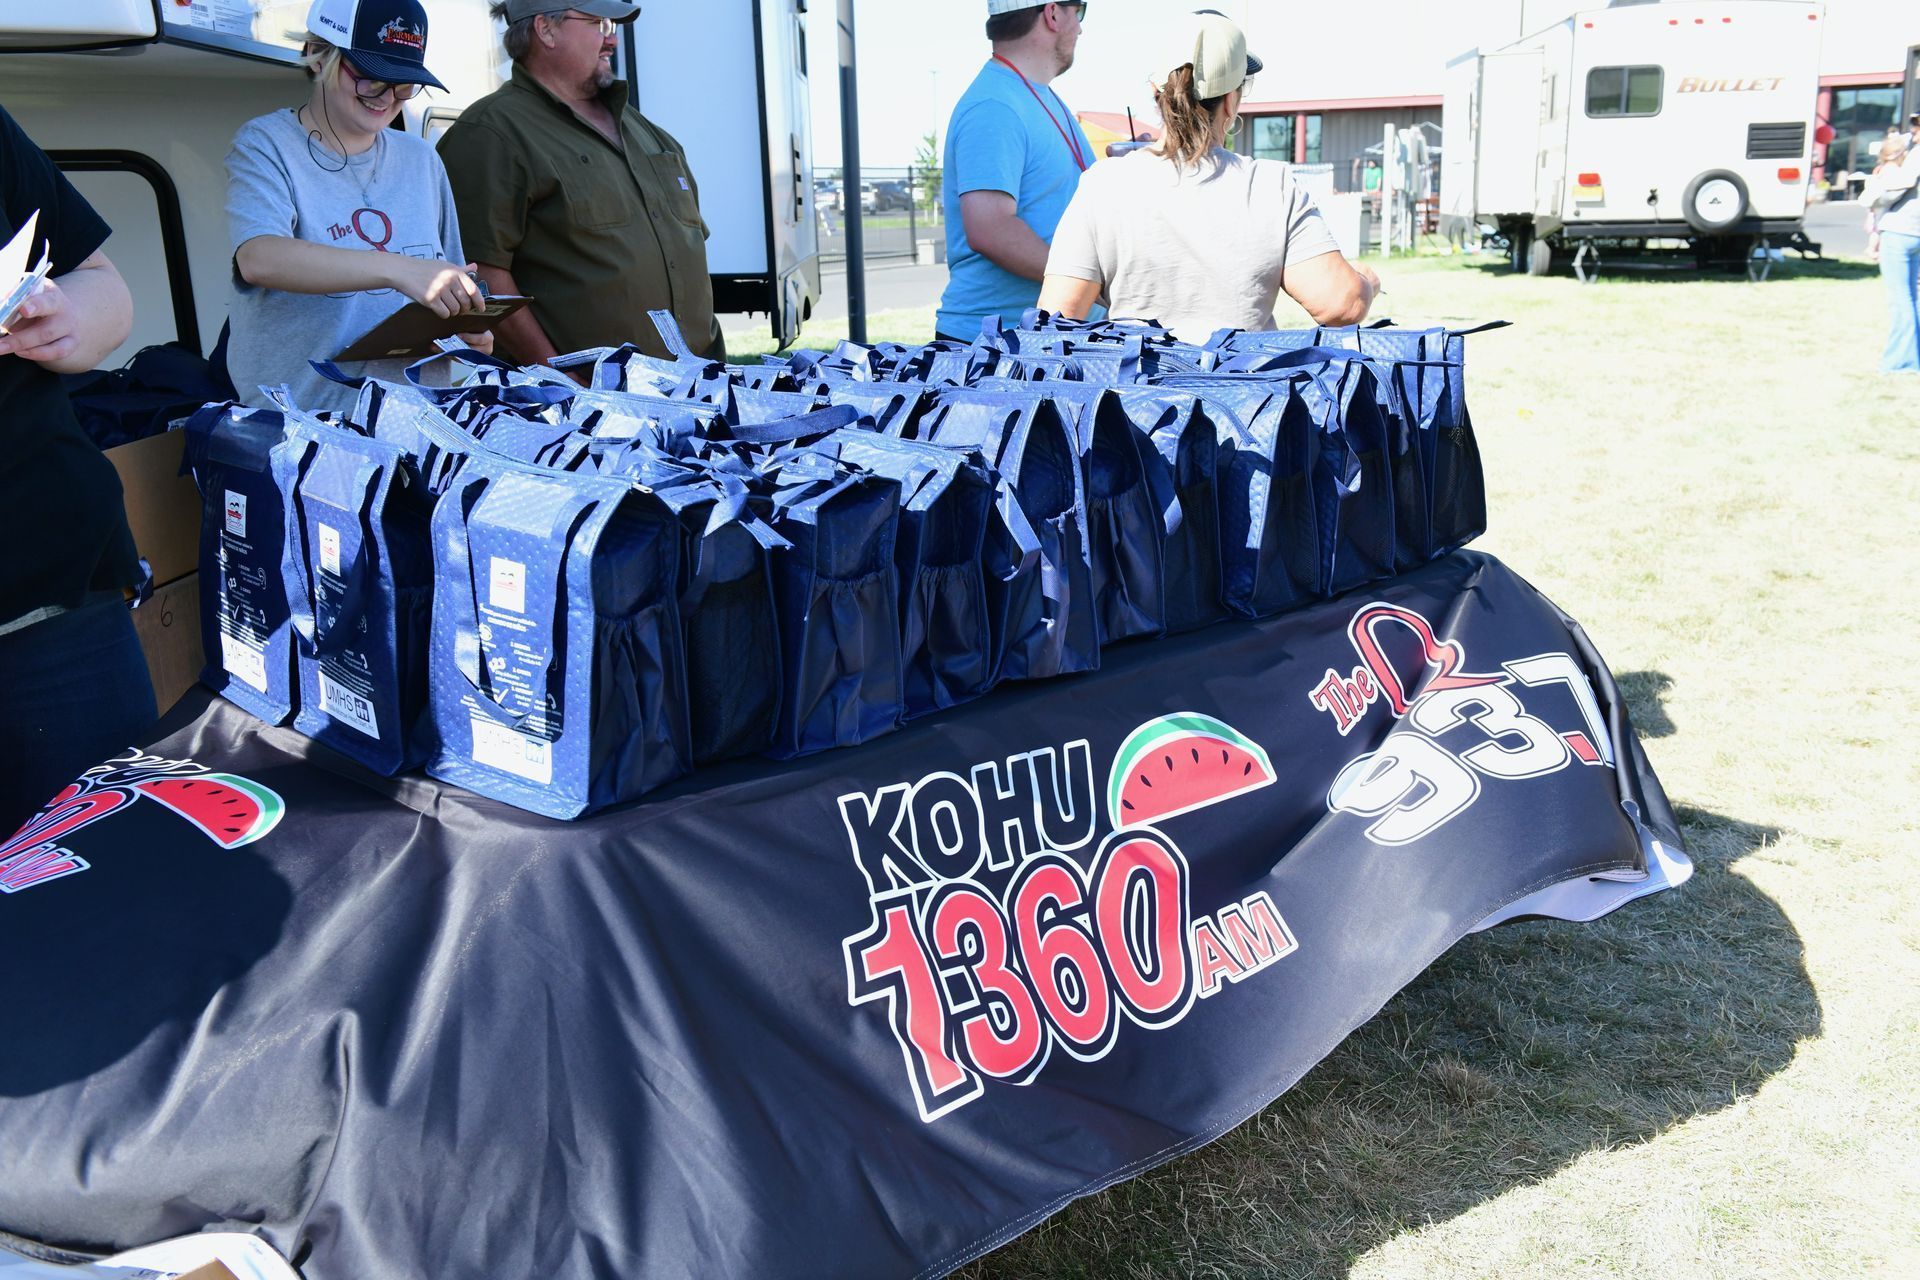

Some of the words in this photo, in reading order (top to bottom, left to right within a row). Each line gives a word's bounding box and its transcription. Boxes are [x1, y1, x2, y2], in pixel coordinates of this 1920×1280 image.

[1676, 77, 1785, 94] BULLET
[326, 223, 353, 241] The
[351, 208, 392, 253] Q
[160, 595, 173, 627] 6
[325, 684, 353, 712] UMHS
[1308, 667, 1378, 737] The
[1326, 652, 1615, 846] 93.7
[836, 738, 1096, 898] KOHU
[843, 826, 1192, 1123] 1360
[1190, 891, 1299, 998] AM
